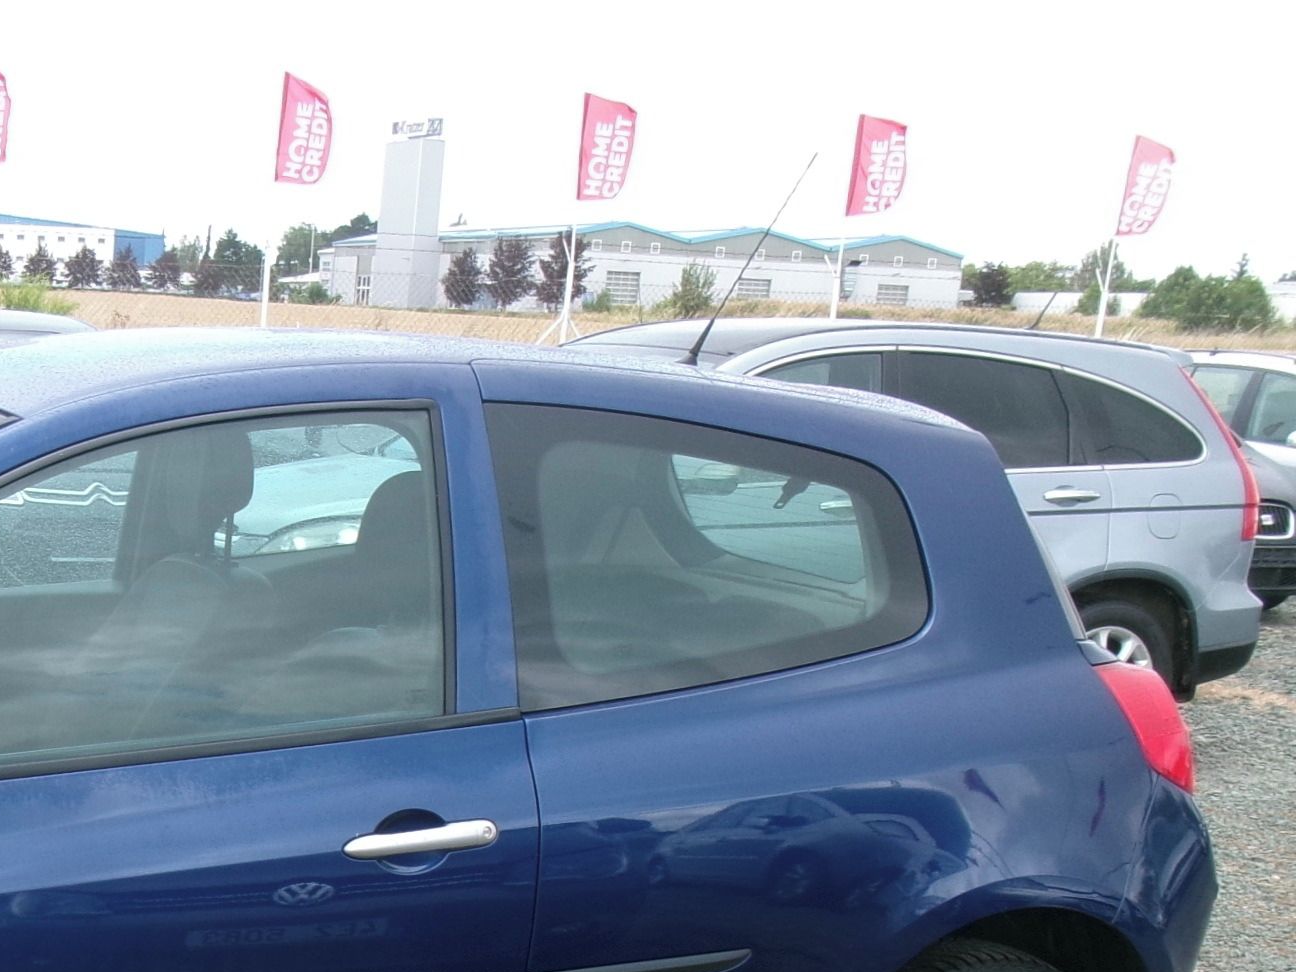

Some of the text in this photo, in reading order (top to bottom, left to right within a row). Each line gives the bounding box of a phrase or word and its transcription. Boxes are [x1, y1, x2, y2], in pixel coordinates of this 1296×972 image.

[282, 101, 314, 179] HOME
[301, 96, 329, 183] CREDIT
[583, 121, 613, 196] HOME
[601, 114, 634, 198] CREDIT
[862, 139, 888, 212] HOME
[878, 131, 905, 212] CREDIT
[1118, 160, 1159, 232] HOME
[1130, 158, 1171, 233] CREDIT
